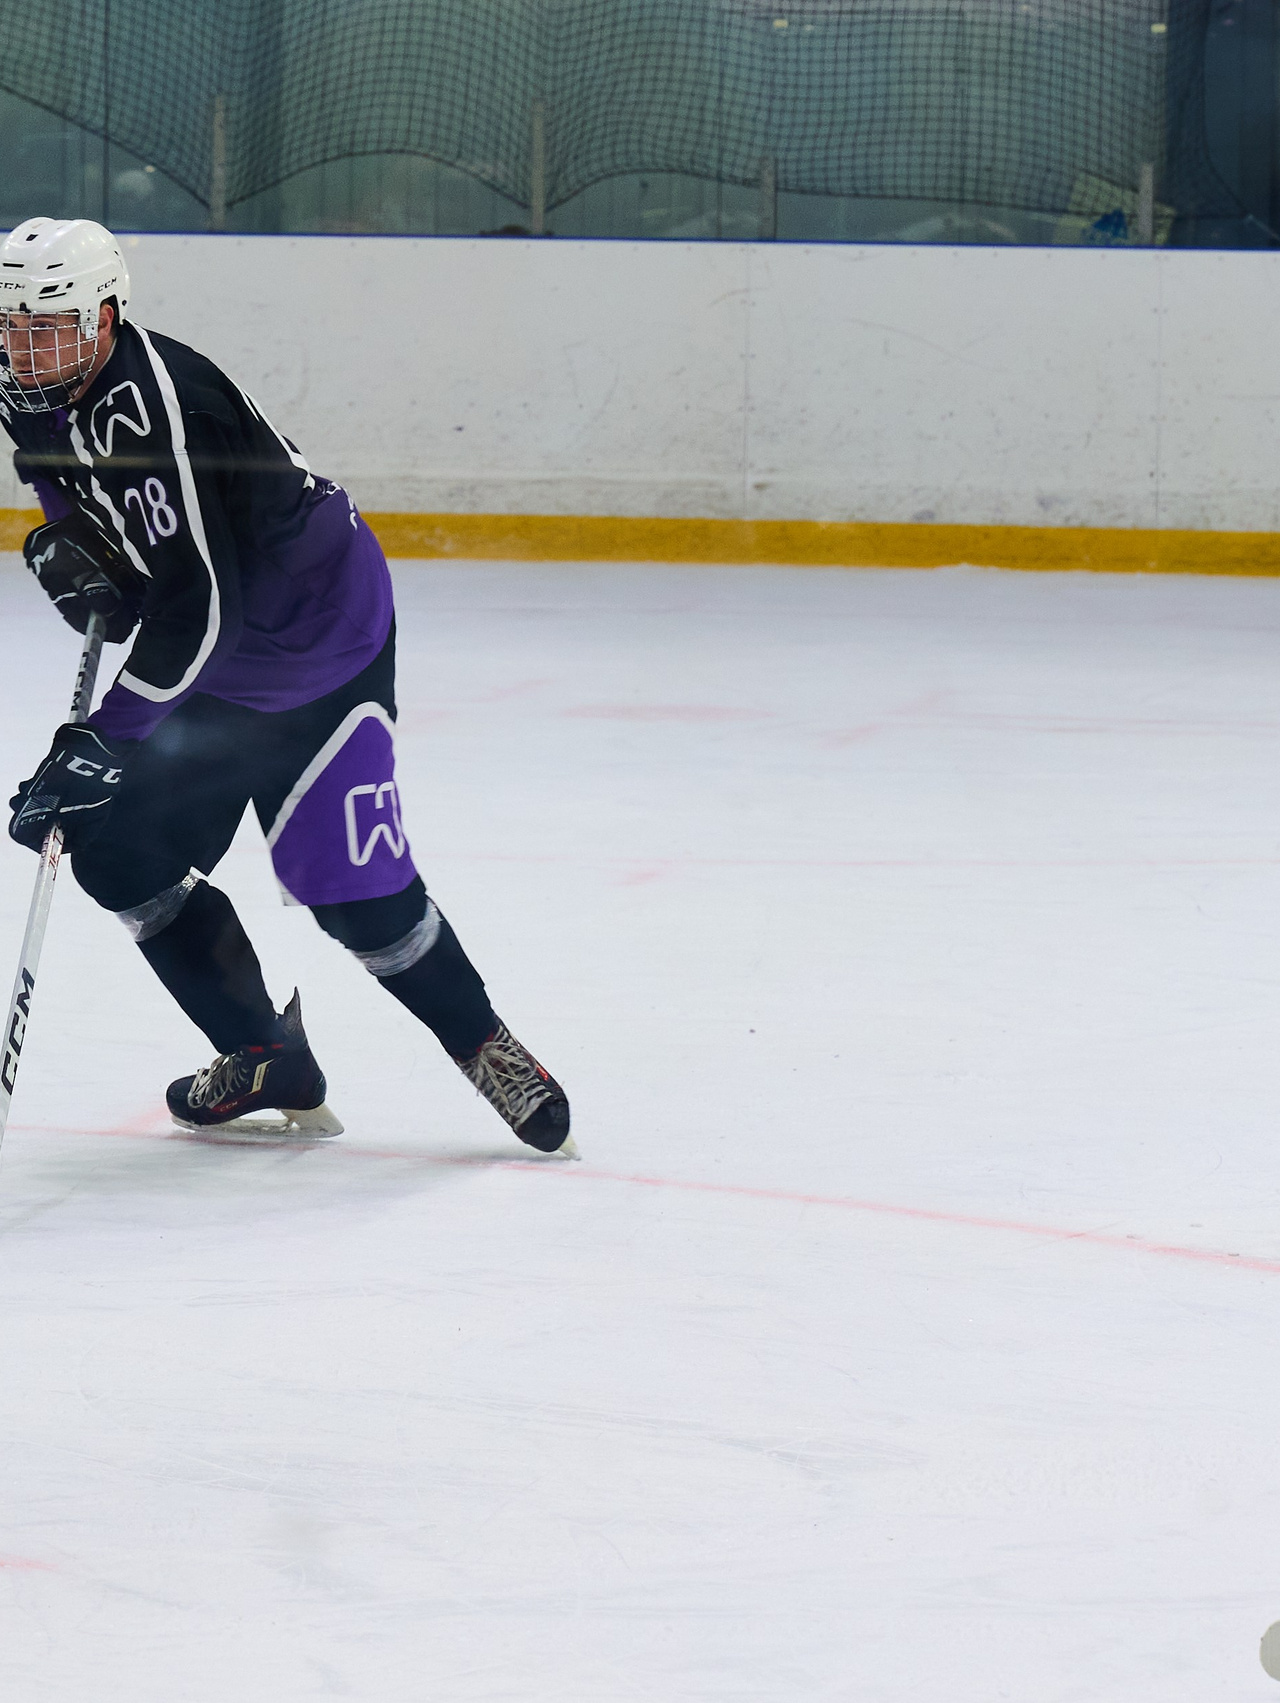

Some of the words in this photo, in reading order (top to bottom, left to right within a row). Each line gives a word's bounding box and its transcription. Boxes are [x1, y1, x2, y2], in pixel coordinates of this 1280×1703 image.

[96, 276, 118, 292] CCM
[70, 651, 90, 712] CCM
[66, 755, 122, 784] CC
[1, 966, 36, 1096] CCM
